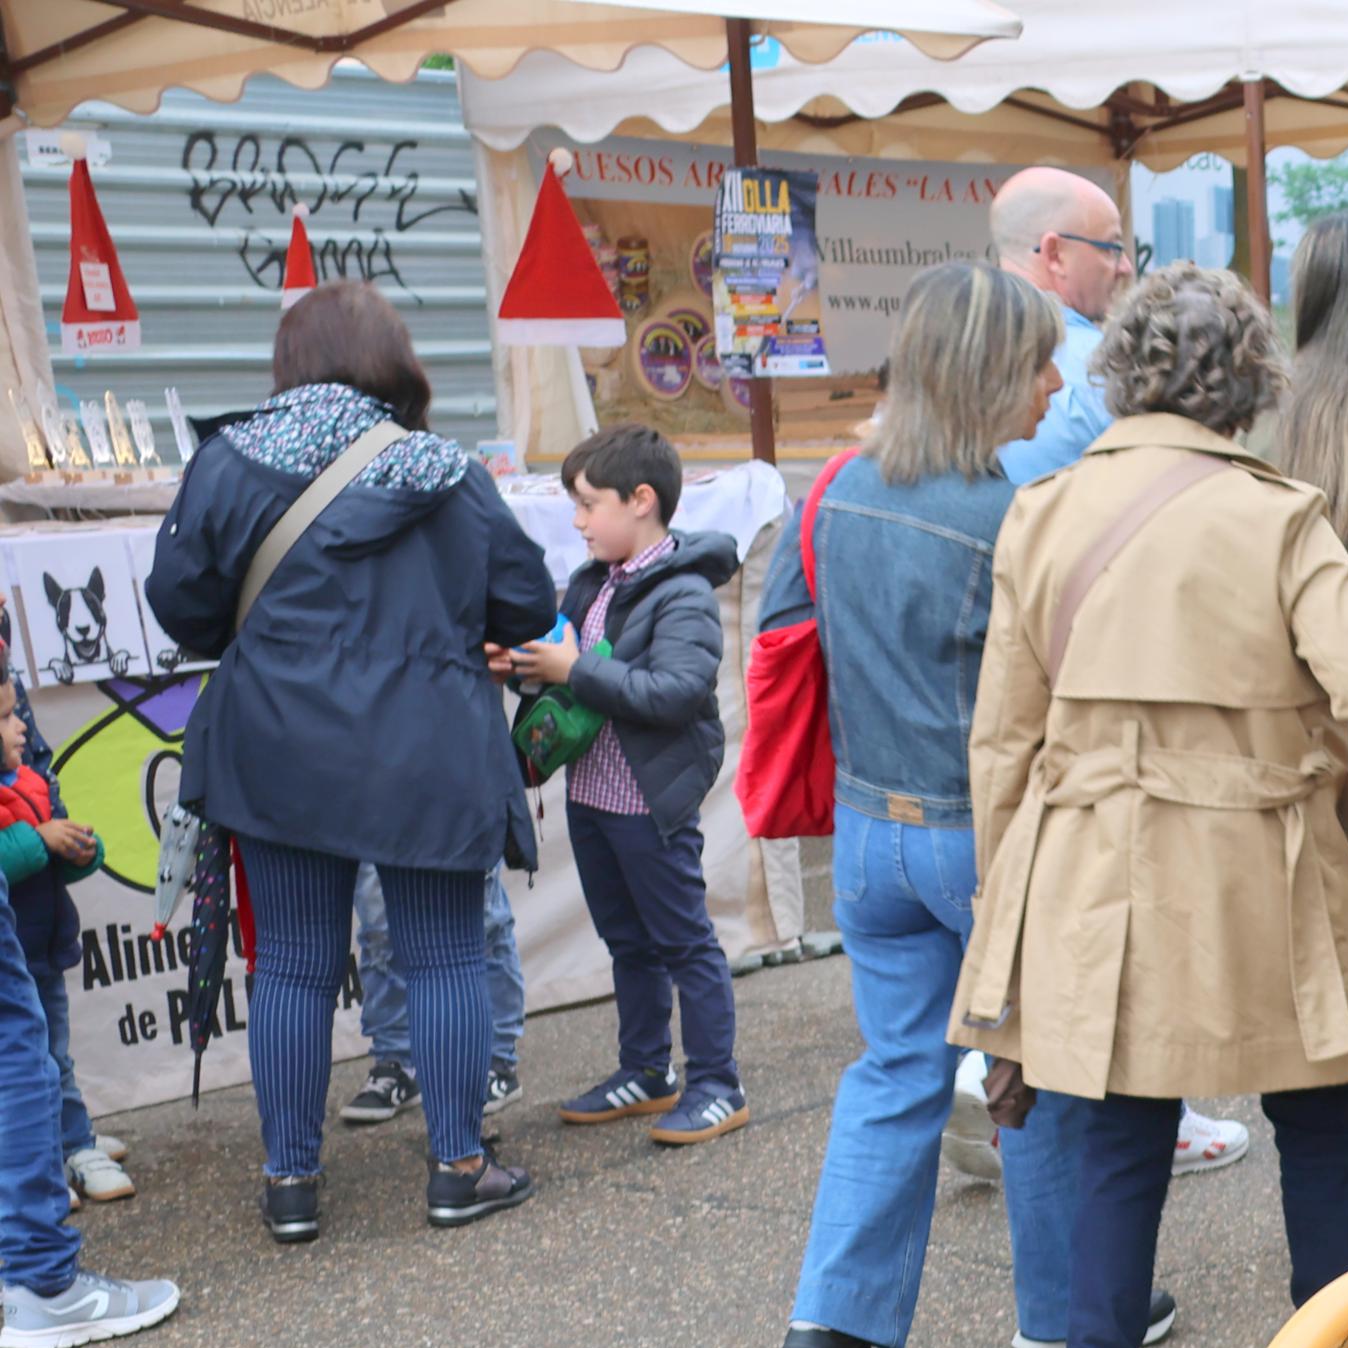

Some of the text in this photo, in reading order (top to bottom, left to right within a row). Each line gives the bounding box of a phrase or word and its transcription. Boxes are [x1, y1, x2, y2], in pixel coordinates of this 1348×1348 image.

[554, 150, 673, 187] UESOS
[743, 178, 790, 213] OLLA
[722, 213, 792, 235] FERROVIARIA
[118, 1003, 158, 1046] de
